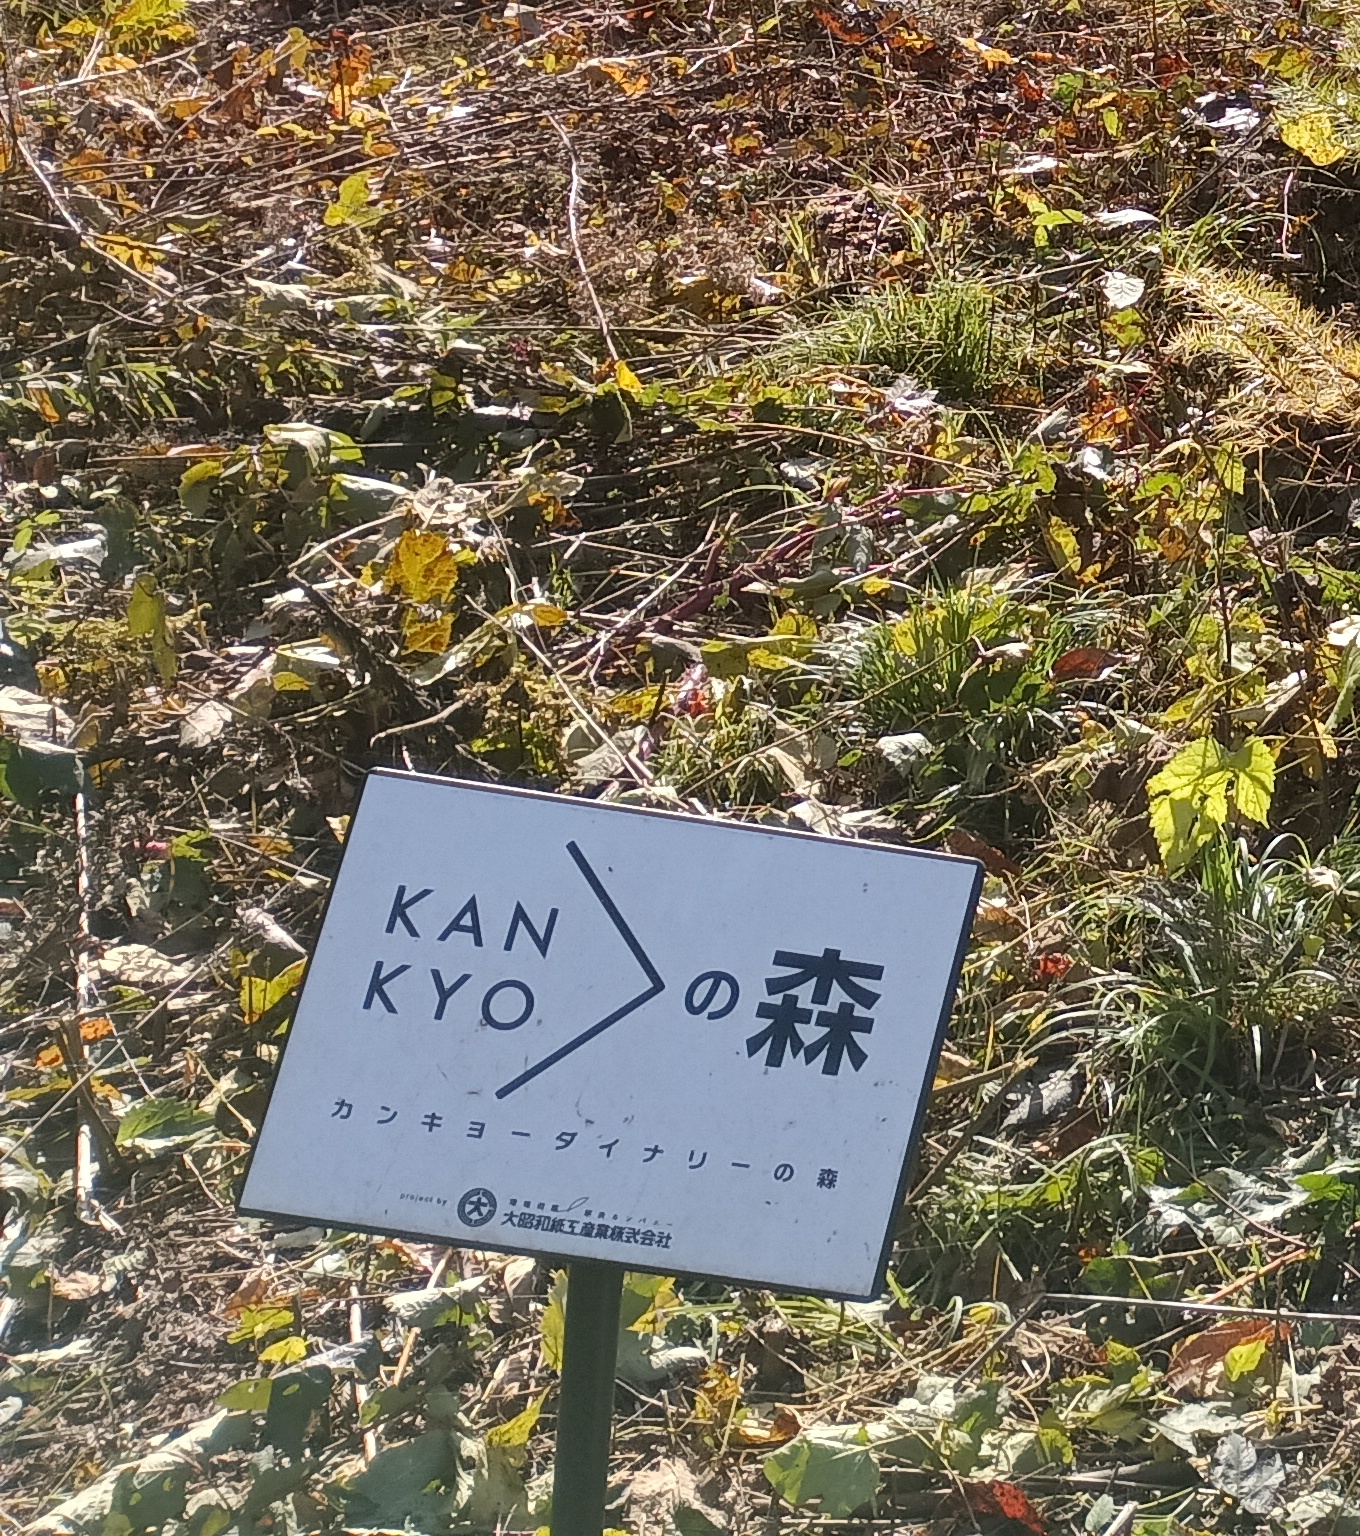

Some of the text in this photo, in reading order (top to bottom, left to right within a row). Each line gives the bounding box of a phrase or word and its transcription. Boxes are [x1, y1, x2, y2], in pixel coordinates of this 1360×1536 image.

[385, 884, 559, 959] KAN
[363, 960, 535, 1031] KYO
[685, 948, 885, 1077] の森
[399, 1193, 448, 1206] project by
